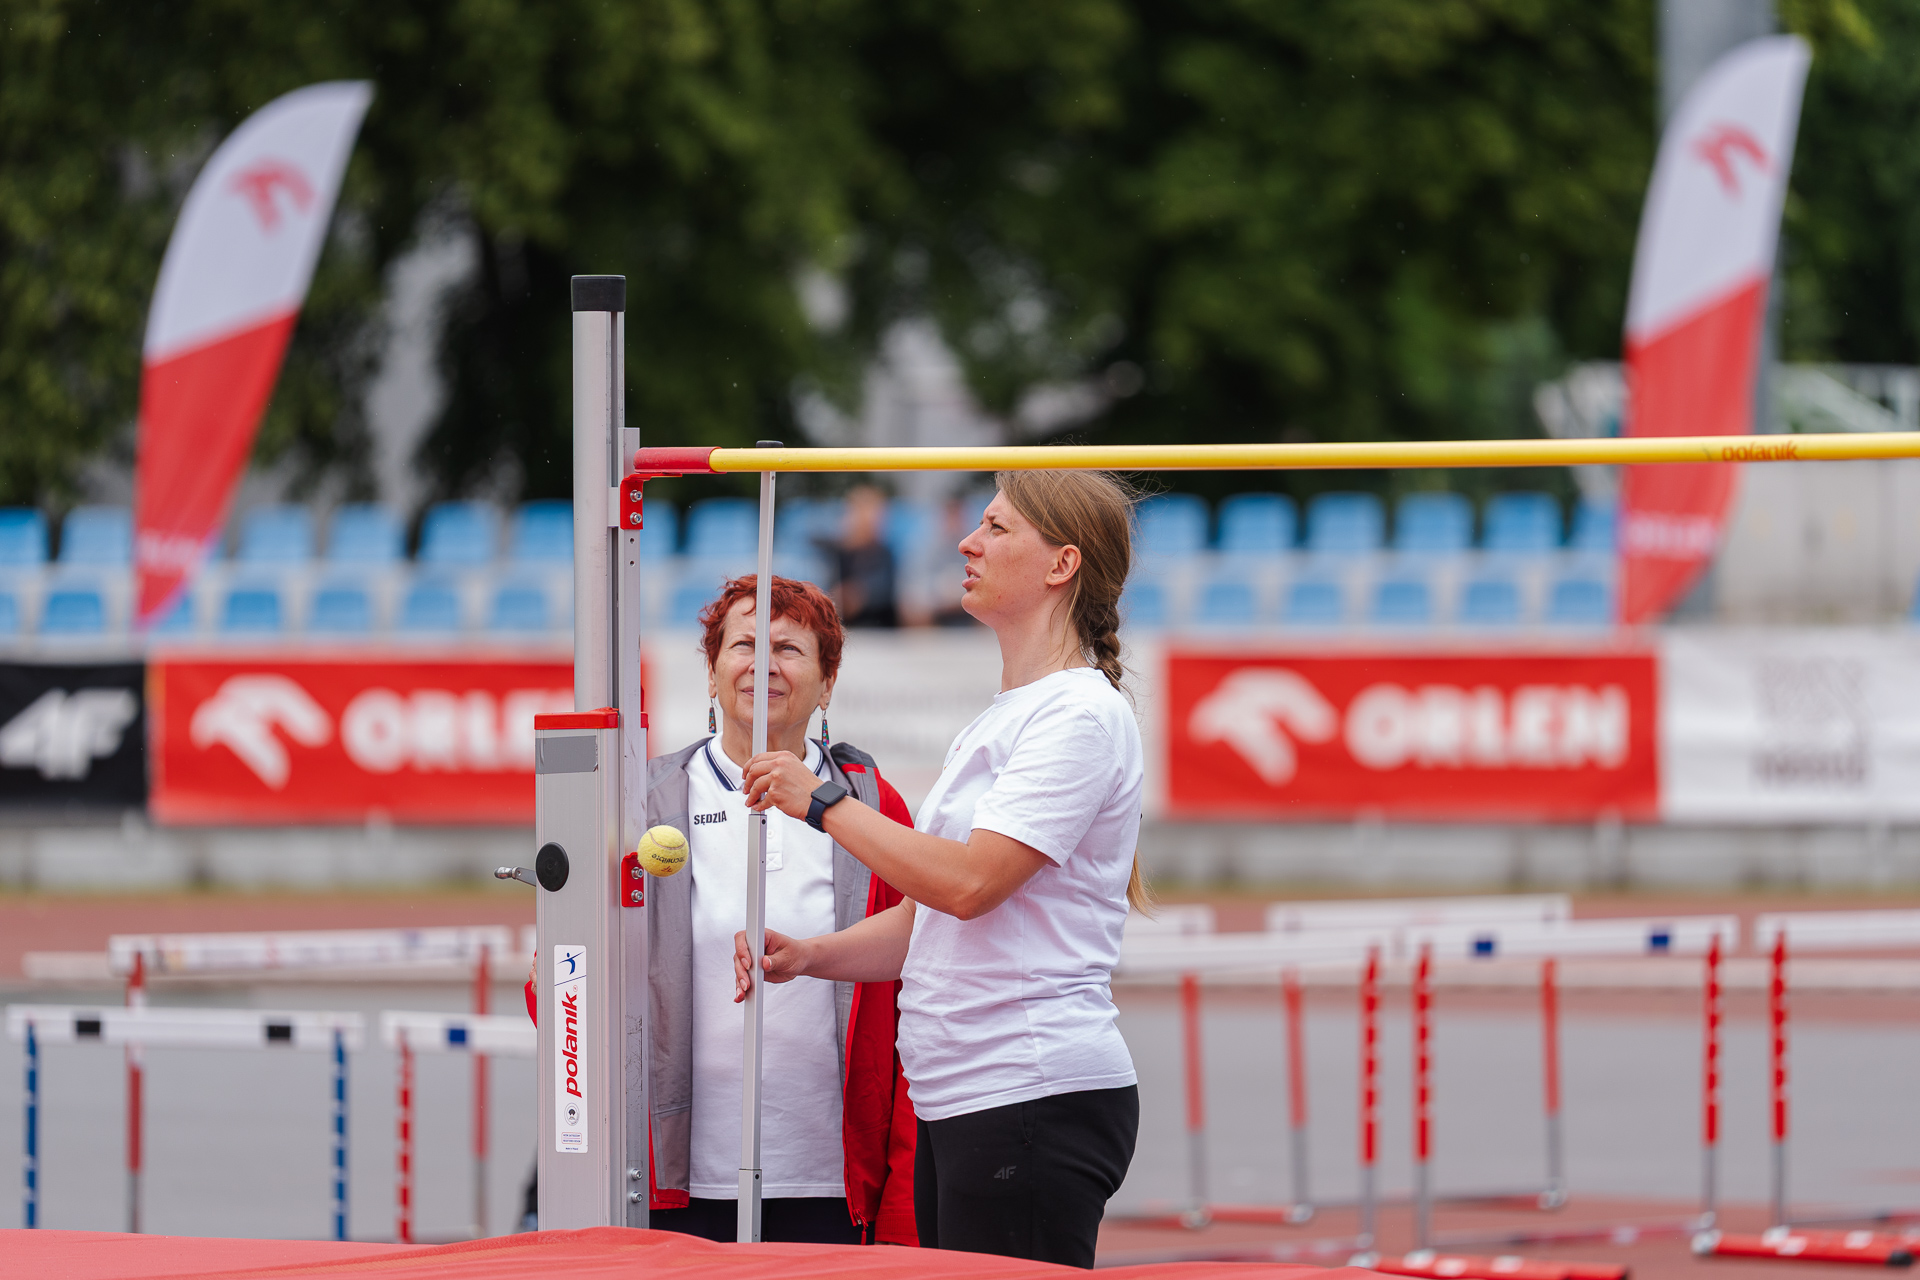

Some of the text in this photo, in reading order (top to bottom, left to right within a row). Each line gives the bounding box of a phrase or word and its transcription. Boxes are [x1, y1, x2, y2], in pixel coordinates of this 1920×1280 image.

[1721, 440, 1799, 462] polanik
[0, 688, 138, 780] 4F
[340, 686, 575, 773] ORLE
[1343, 682, 1631, 770] ORLEN
[693, 810, 728, 826] SĘDZIA
[561, 991, 583, 1098] polanik
[993, 1165, 1017, 1180] 4F
